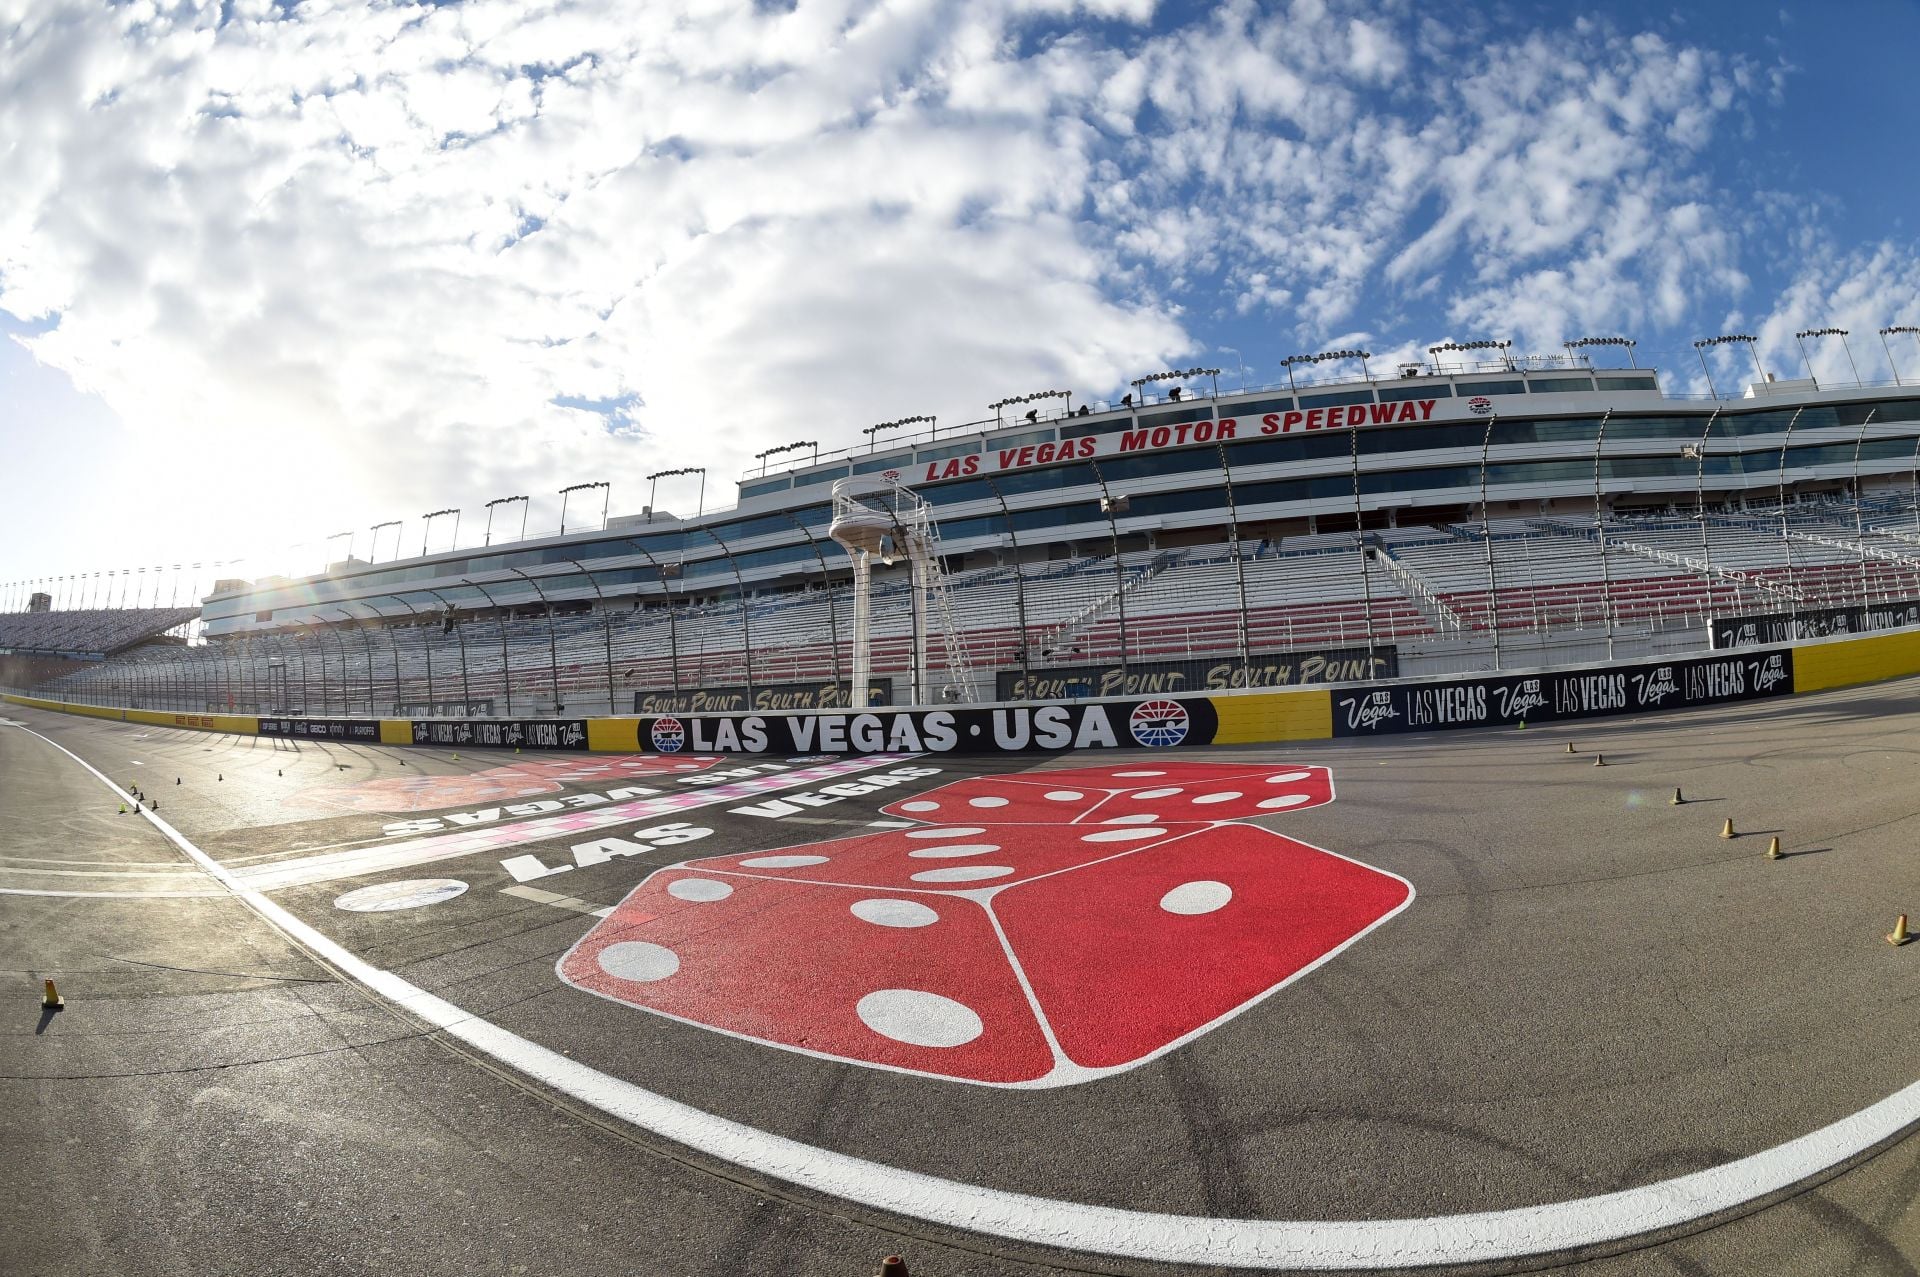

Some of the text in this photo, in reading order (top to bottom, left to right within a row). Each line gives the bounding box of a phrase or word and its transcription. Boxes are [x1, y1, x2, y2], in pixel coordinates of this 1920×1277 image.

[926, 400, 1436, 481] LAS VEGAS MOTOR SPEEDWAY
[1101, 669, 1186, 696] POINT
[1205, 656, 1386, 689] SOUTH POINT
[1524, 680, 1540, 692] LAS
[1632, 670, 1679, 705] Vegas
[1684, 661, 1744, 700] LAS VEGAS
[1749, 658, 1788, 691] Vegas
[643, 692, 742, 714] SOUTH POINT
[754, 690, 814, 711] SOUTH
[1373, 692, 1390, 704] LAS
[1407, 686, 1487, 726] LAS VEGAS
[1493, 682, 1549, 718] Vegas
[1555, 673, 1625, 713] LAS VEGAS
[691, 704, 1118, 753] LAS VEGAS USA
[1340, 695, 1400, 729] Vegas
[310, 724, 326, 734] GEICO
[354, 726, 375, 736] PLAYOFFS
[438, 724, 453, 743] VEGAS
[483, 724, 501, 744] VEGAS
[536, 724, 558, 745] VEGAS
[559, 724, 586, 746] Vegas
[382, 786, 663, 836] VEGAS
[499, 766, 943, 882] LAS VEGAS
